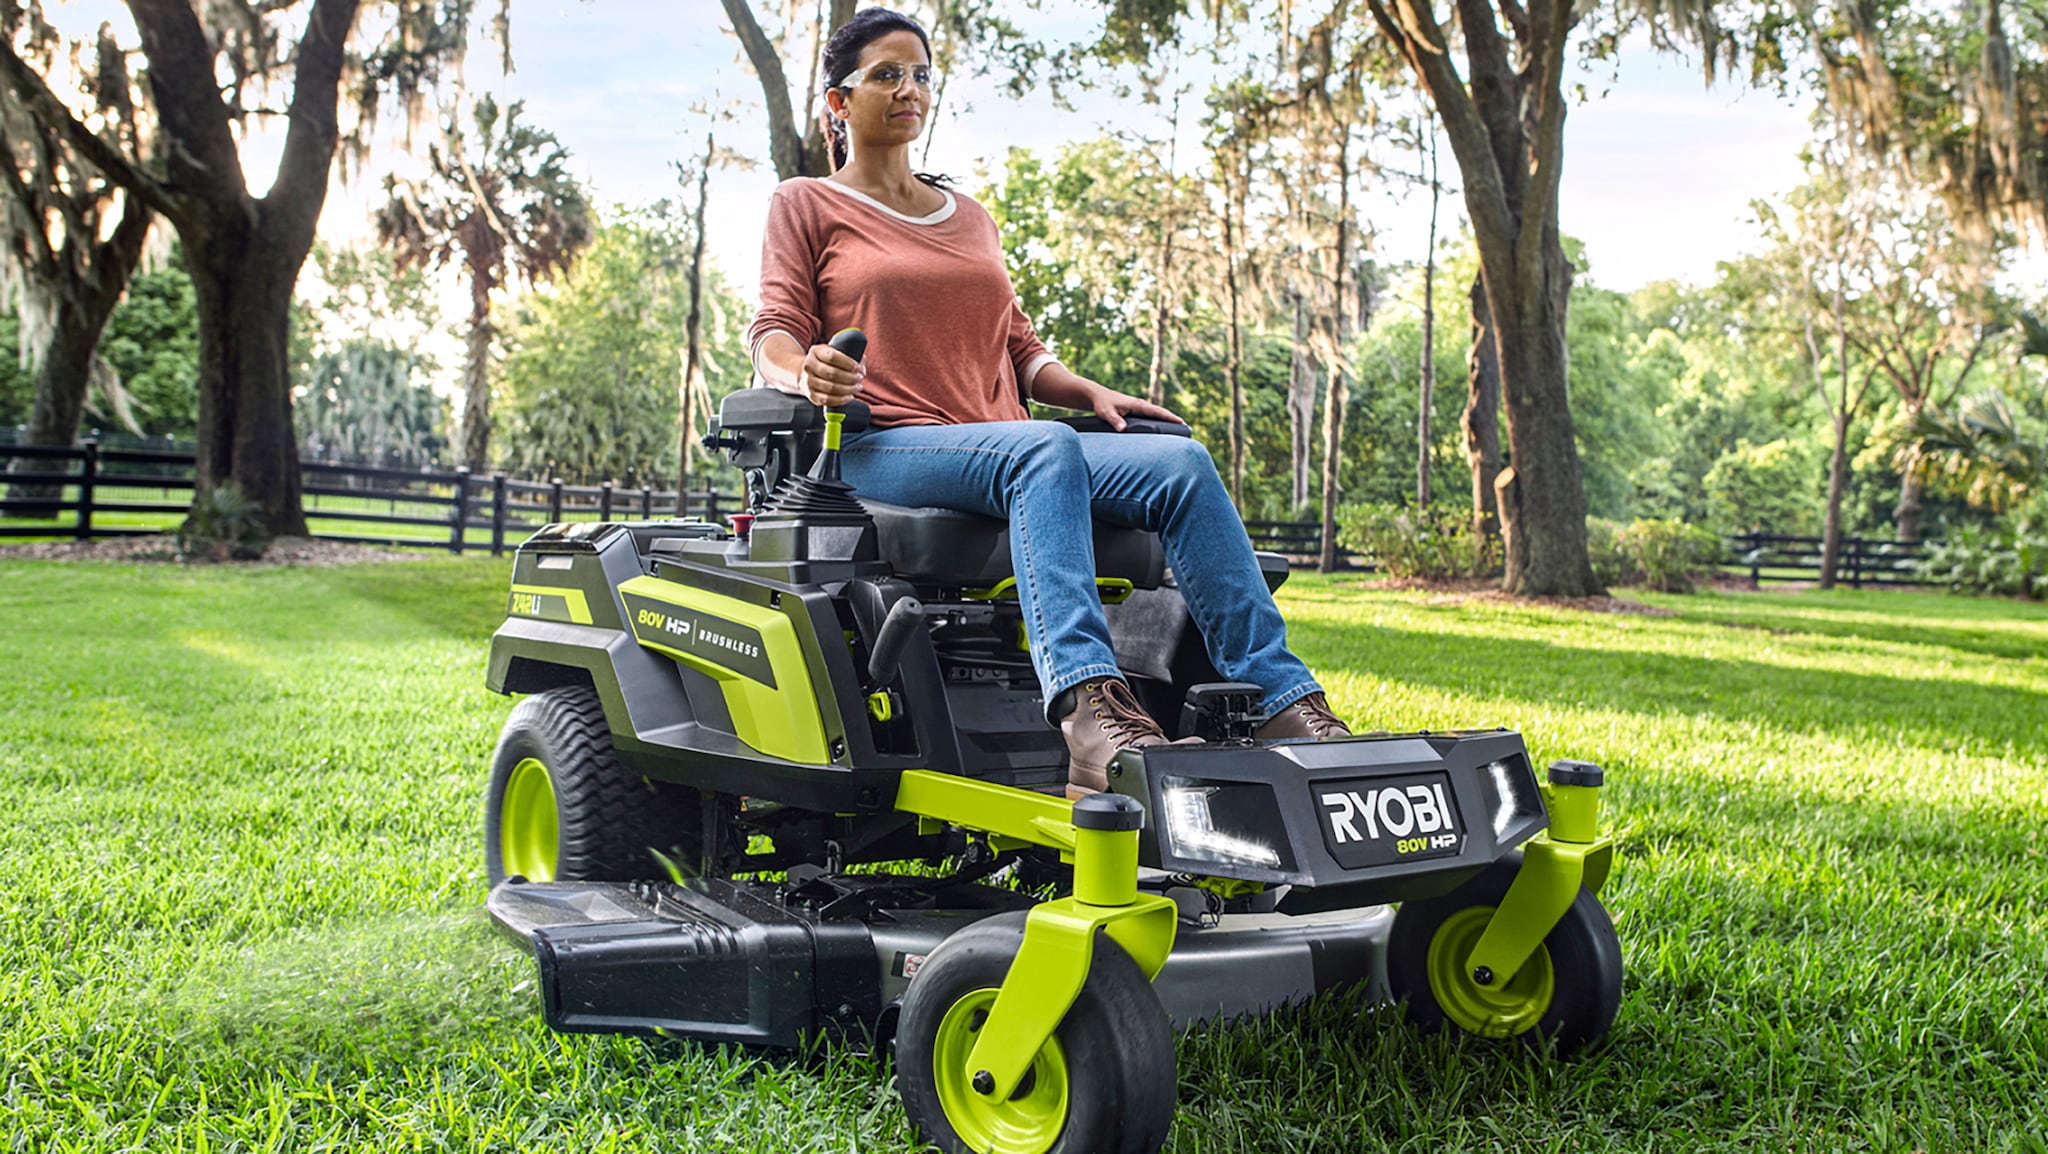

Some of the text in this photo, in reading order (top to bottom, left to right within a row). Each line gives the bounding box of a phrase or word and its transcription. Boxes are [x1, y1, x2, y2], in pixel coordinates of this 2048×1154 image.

[512, 593, 541, 615] Z42Li
[637, 609, 759, 658] 80V HP BRUSHLESS
[1321, 783, 1453, 843] RYOBI
[1396, 834, 1457, 854] 80V HP
